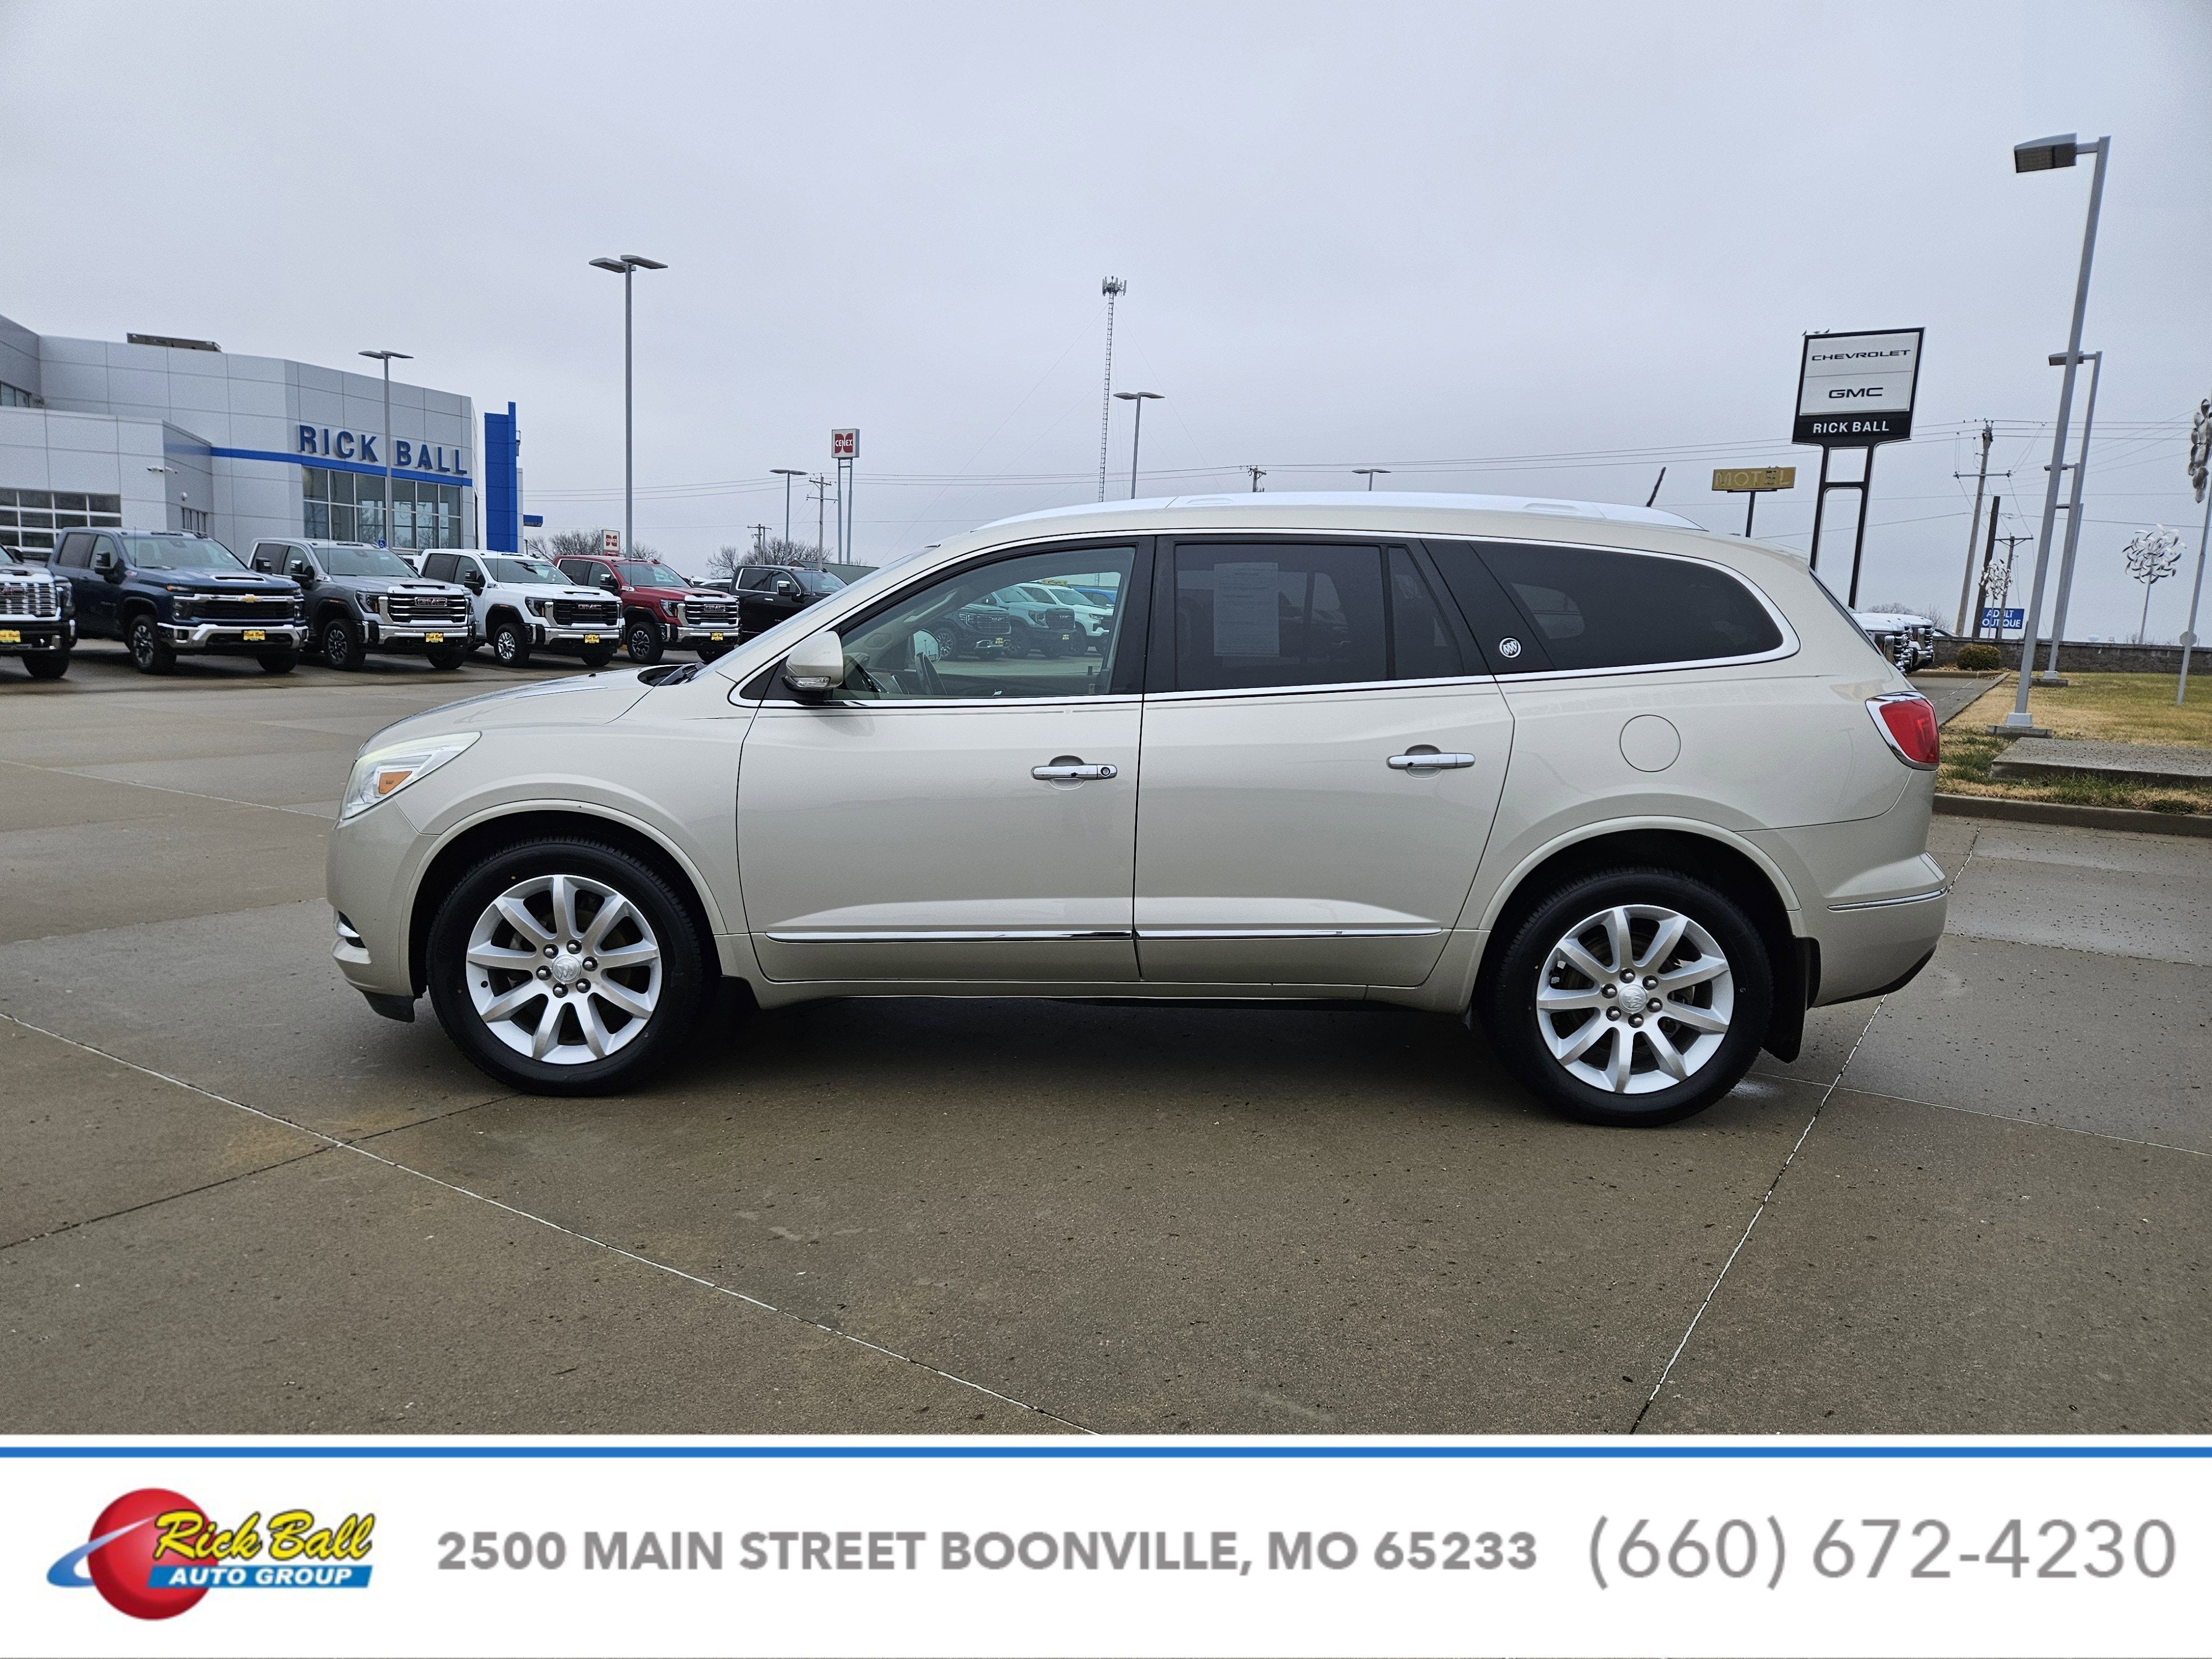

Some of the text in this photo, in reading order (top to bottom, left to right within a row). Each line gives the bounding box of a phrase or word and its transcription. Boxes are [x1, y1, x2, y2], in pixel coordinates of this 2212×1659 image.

[1812, 349, 1911, 361] CHEVROLET
[1829, 387, 1884, 399] GMC
[1813, 421, 1890, 434] RICK BALL
[299, 425, 467, 474] RICK BALL
